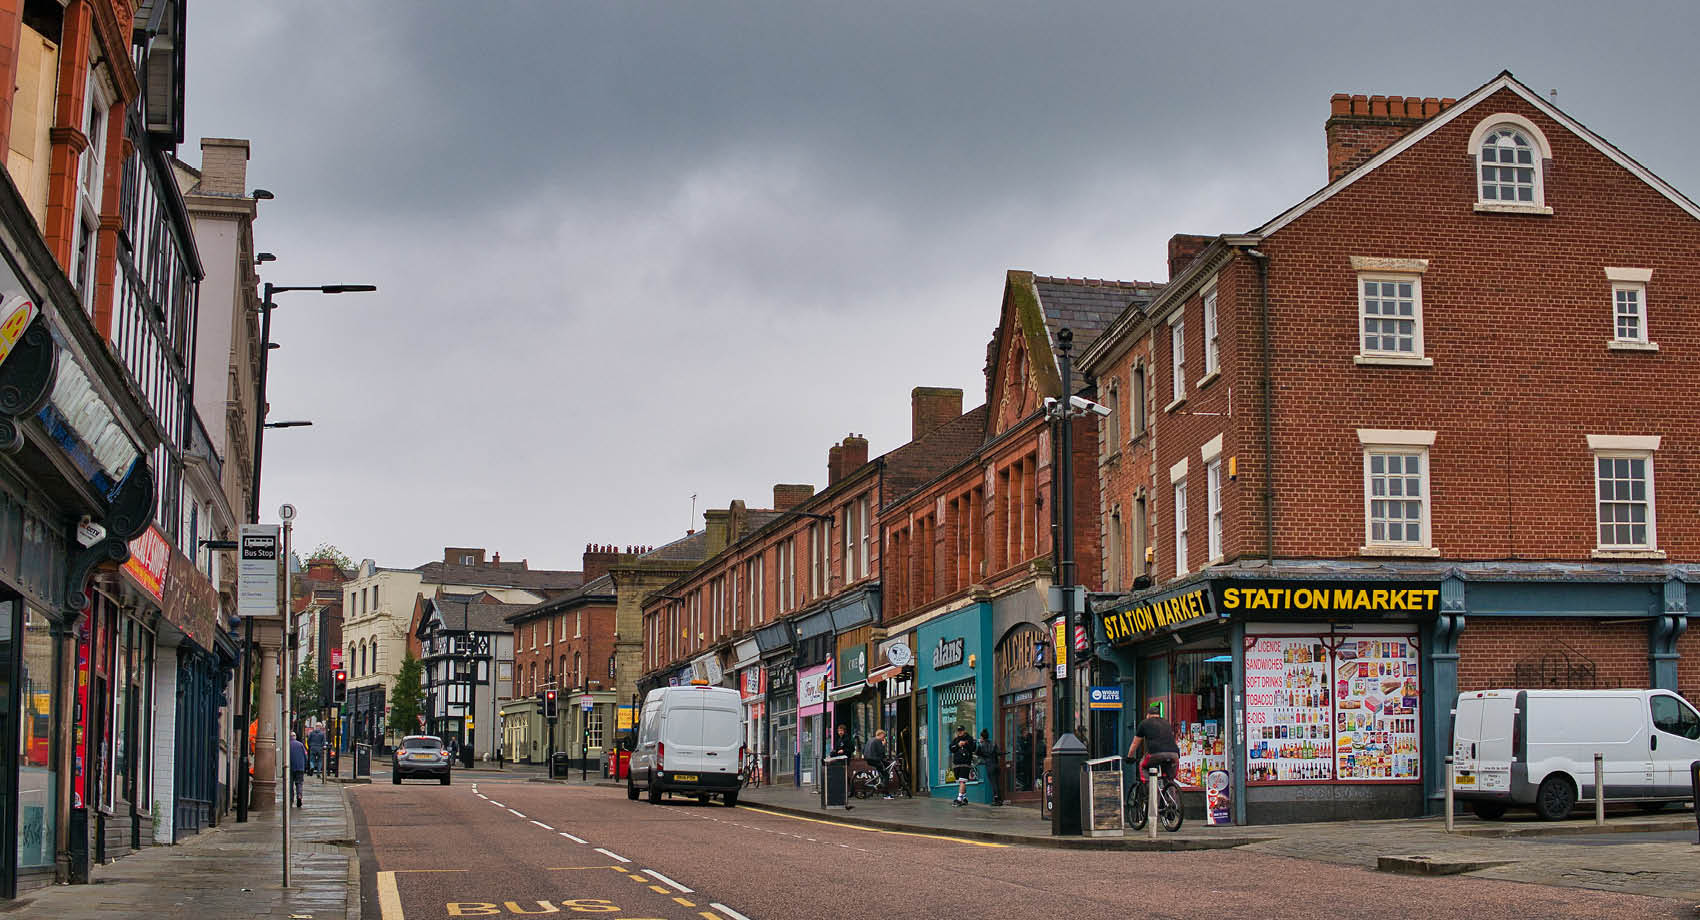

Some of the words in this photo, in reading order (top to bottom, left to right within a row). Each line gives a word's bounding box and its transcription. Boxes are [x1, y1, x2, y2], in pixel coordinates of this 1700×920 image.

[283, 505, 293, 519] D
[86, 526, 100, 537] CCTV
[244, 549, 257, 557] Bus
[258, 549, 274, 558] Stop
[1223, 588, 1329, 609] STATION
[1333, 589, 1439, 610] MARKET
[1104, 605, 1155, 640] STATION
[1152, 589, 1206, 627] MARKET
[1257, 640, 1281, 652] LICENCE
[933, 638, 962, 669] alans
[1002, 631, 1047, 679] ALCHEM
[1246, 658, 1283, 670] SANDWICHES
[1246, 677, 1261, 688] SOFT
[1262, 676, 1283, 688] DRINKS
[1246, 694, 1274, 706] TOBACCO
[1247, 712, 1266, 724] E-CIGS
[446, 899, 622, 916] BUS
